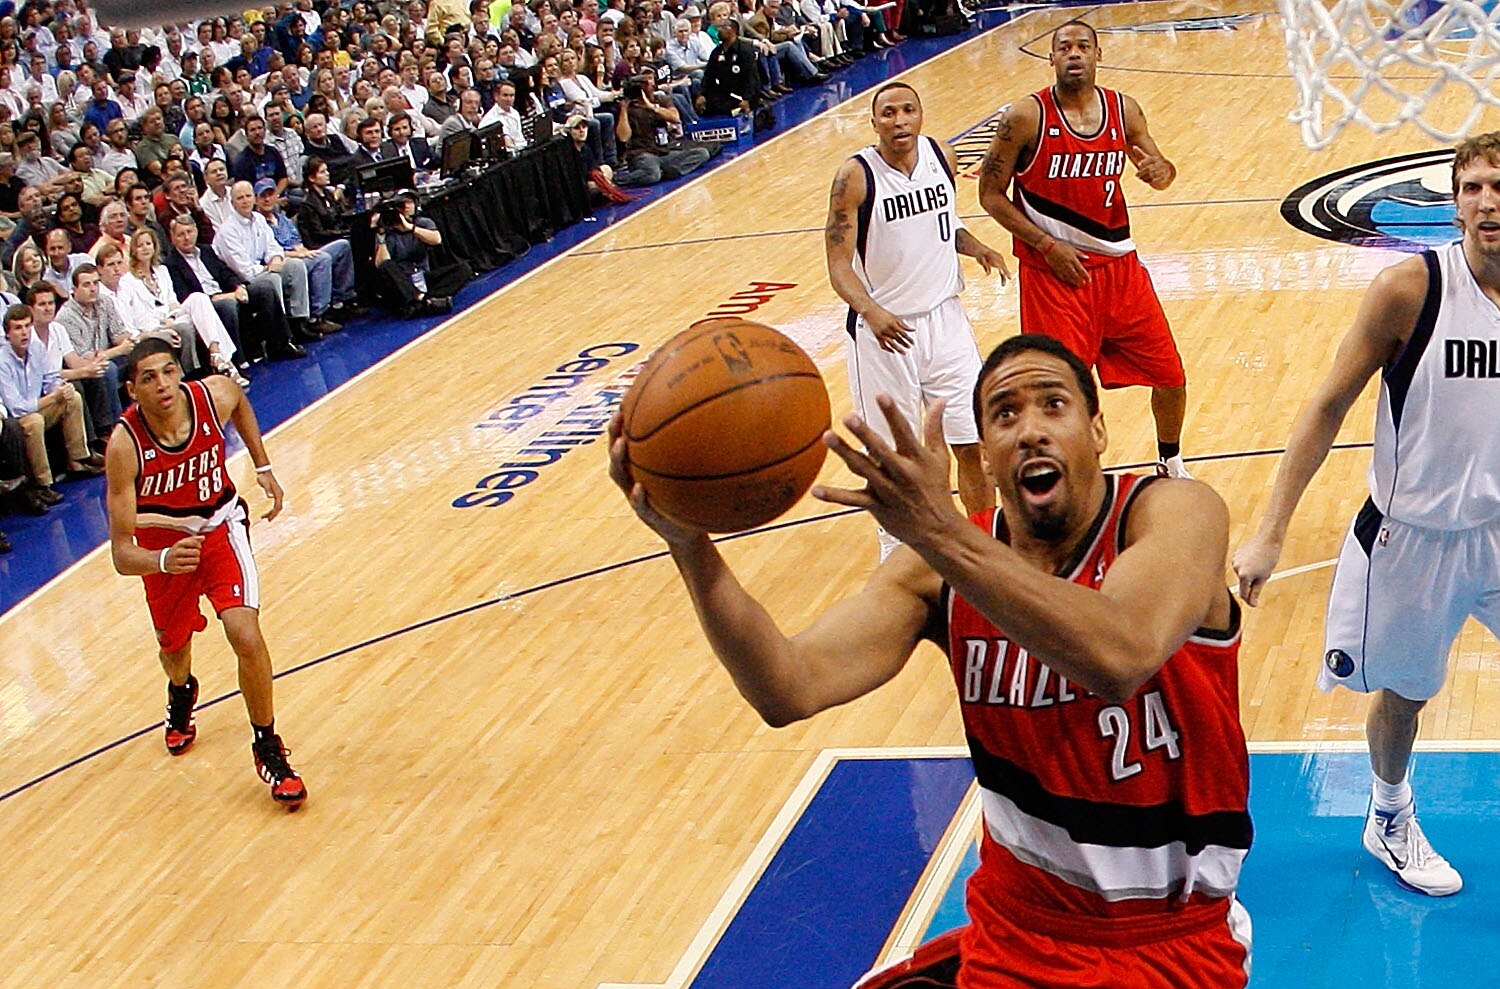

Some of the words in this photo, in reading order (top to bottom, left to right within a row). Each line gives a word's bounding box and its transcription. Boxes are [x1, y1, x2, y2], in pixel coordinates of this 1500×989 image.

[1048, 150, 1124, 179] BLAZERS
[882, 183, 949, 222] DALLAS
[1105, 180, 1116, 208] 2
[937, 210, 951, 243] 0
[474, 342, 640, 434] Center
[140, 444, 220, 497] BLAZERS
[198, 466, 223, 502] 88
[1097, 690, 1181, 781] 24
